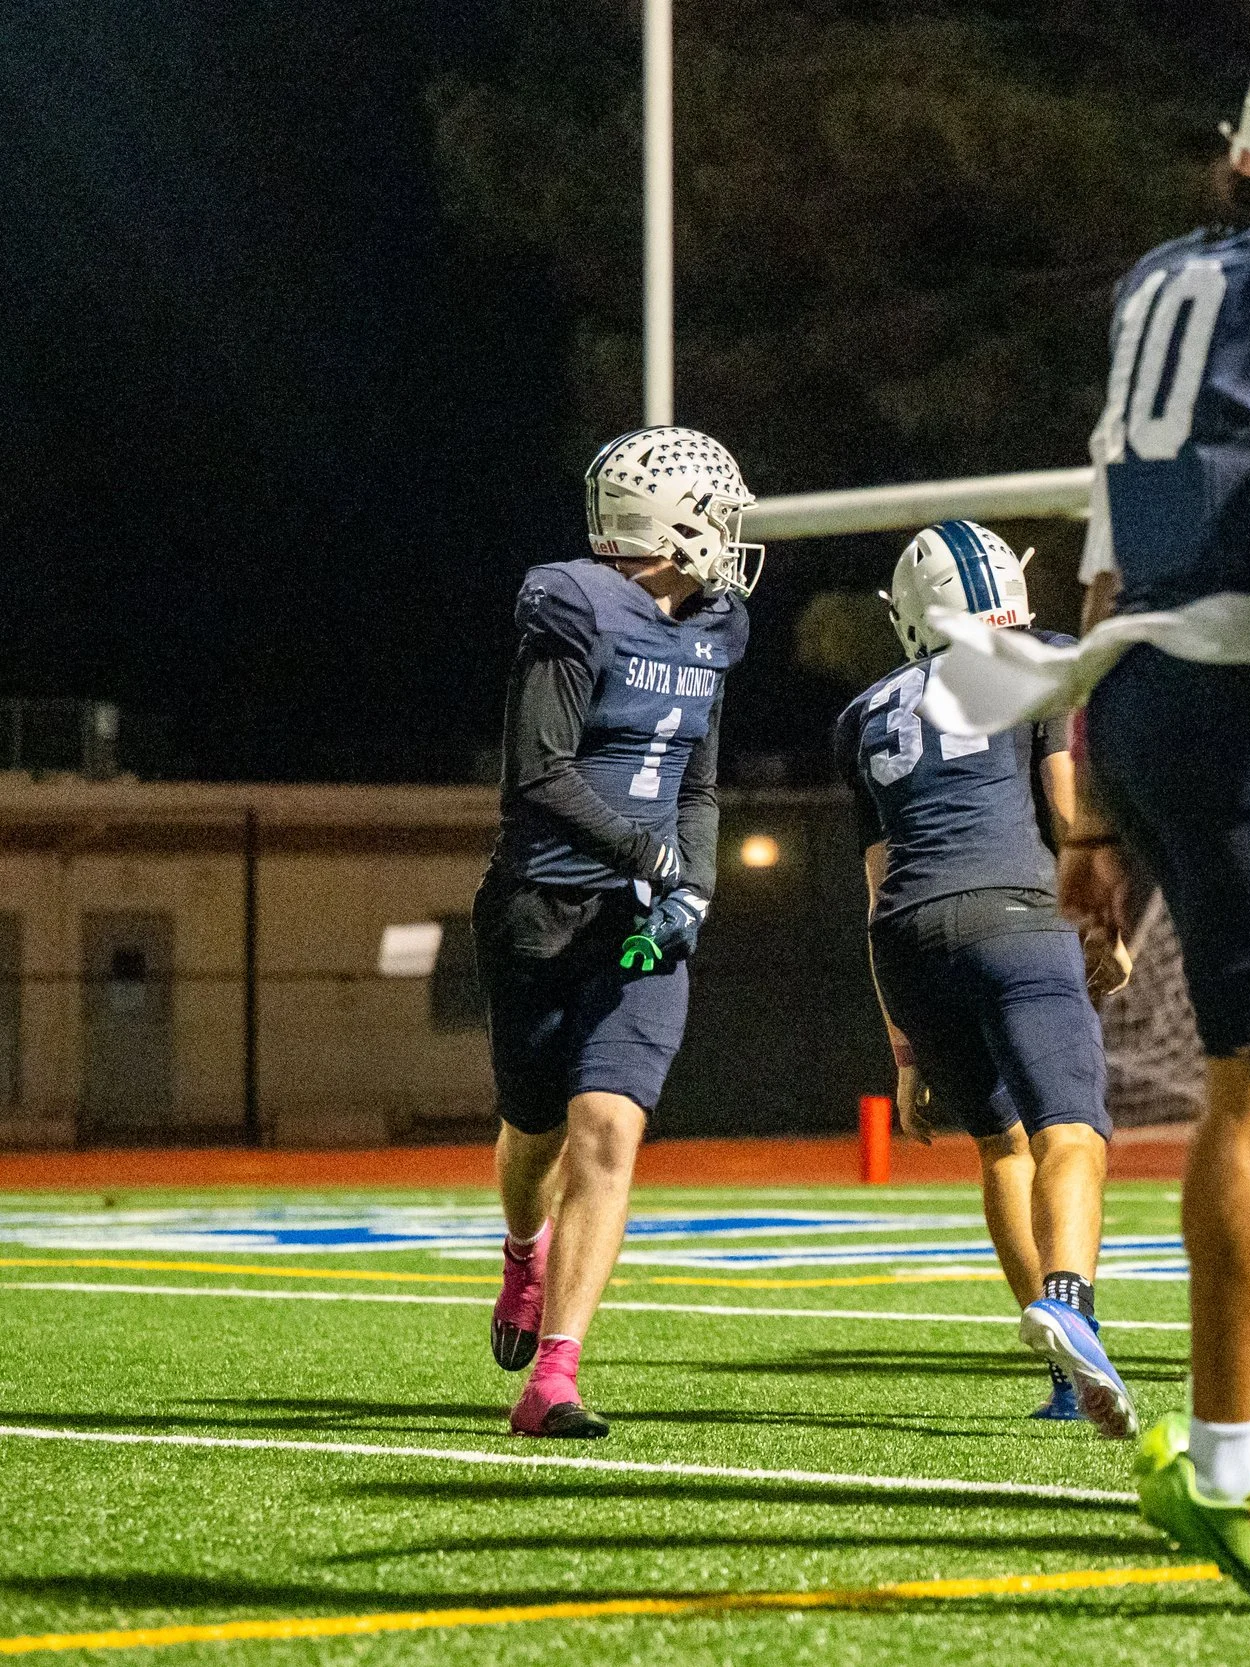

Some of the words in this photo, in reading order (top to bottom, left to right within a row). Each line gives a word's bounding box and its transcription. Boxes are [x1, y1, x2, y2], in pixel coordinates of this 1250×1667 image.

[1106, 259, 1227, 461] 10
[625, 656, 670, 694] SANTA
[868, 651, 990, 787] 3
[628, 707, 683, 798] 1
